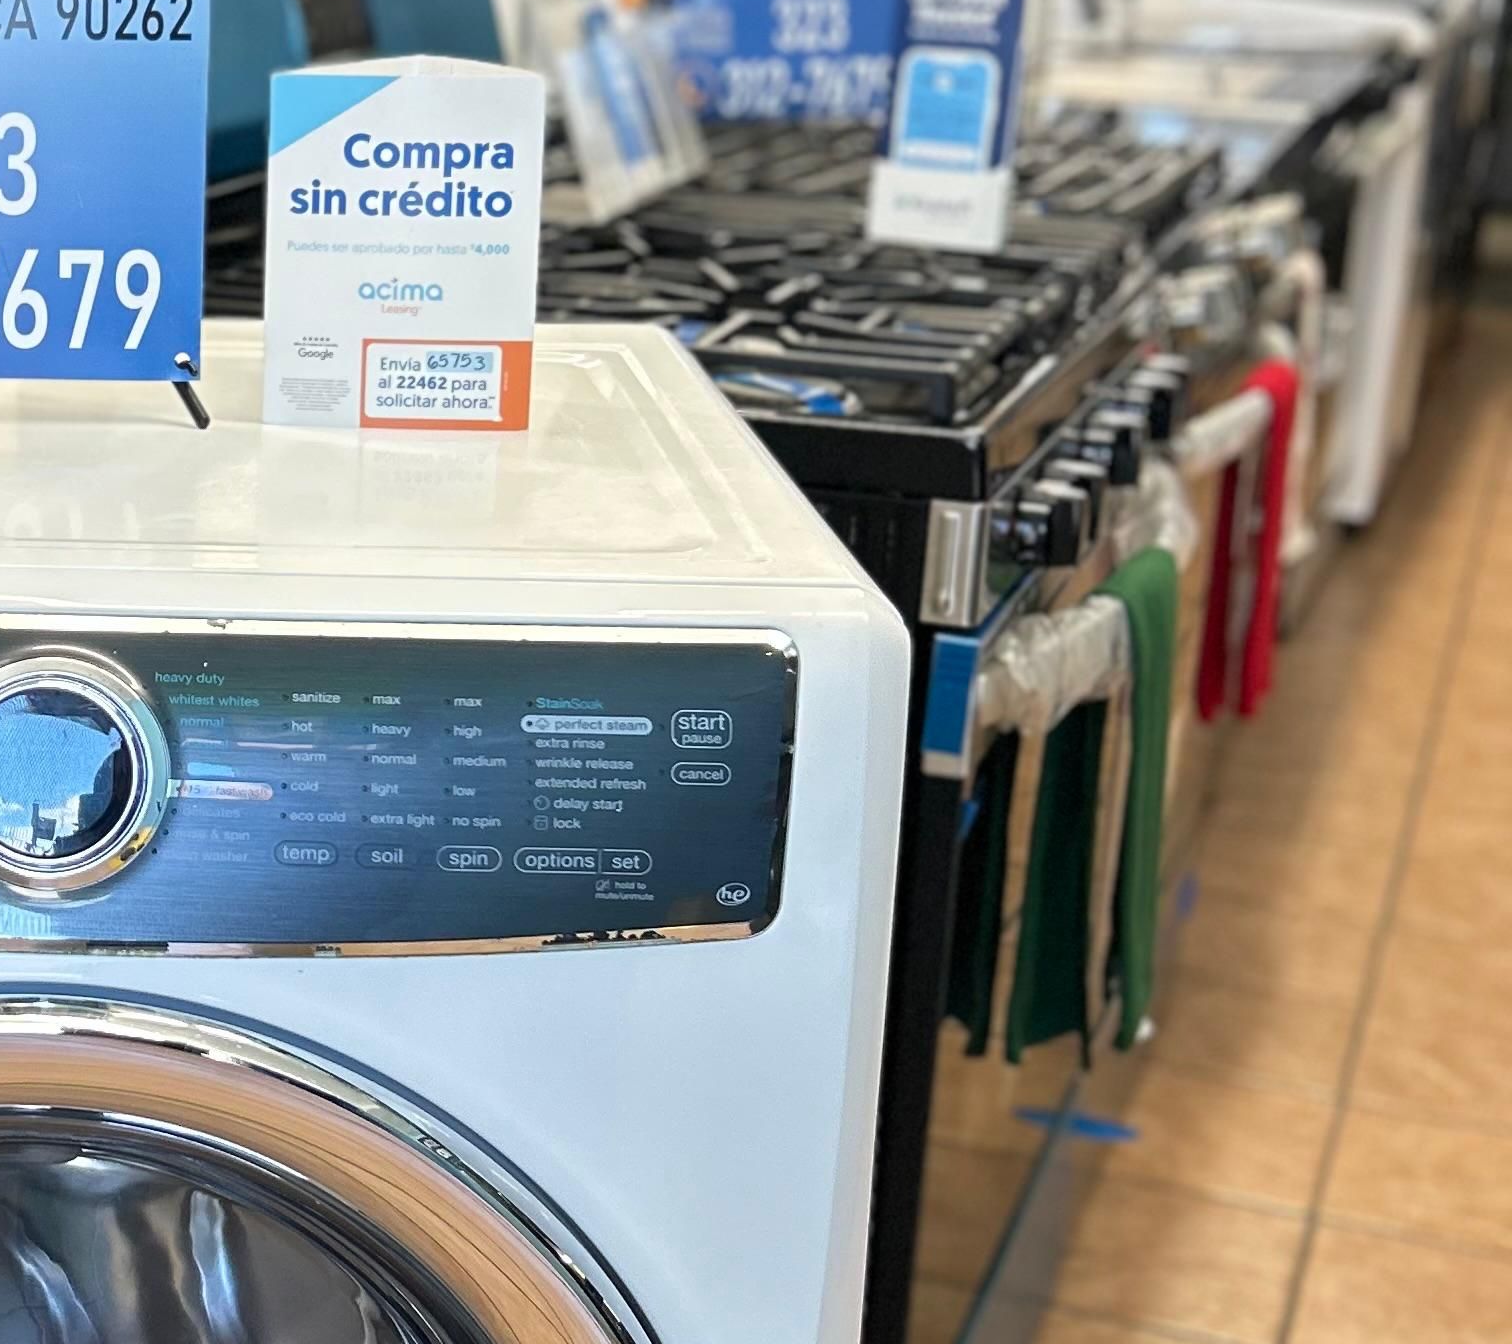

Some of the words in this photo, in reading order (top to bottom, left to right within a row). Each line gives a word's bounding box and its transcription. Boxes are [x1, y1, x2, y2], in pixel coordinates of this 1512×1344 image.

[344, 133, 514, 177] Compra
[290, 179, 346, 215] sin
[359, 181, 512, 217] crédito
[287, 241, 328, 252] Puedes
[332, 243, 348, 253] ser
[352, 242, 410, 255] aprobado
[413, 244, 434, 256] por
[437, 243, 467, 254] hasta
[358, 278, 443, 301] acima
[381, 304, 418, 316] Leasing
[297, 347, 334, 360] Google
[380, 357, 421, 372] Envía
[427, 353, 486, 371] 65753
[378, 375, 391, 388] al
[396, 376, 447, 389] 22462
[451, 379, 487, 392] para
[377, 394, 436, 408] solicitar
[155, 672, 192, 685] heavy
[196, 673, 224, 686] duty
[168, 694, 214, 706] whitest
[219, 695, 260, 707] whites
[291, 692, 340, 703] sanitize
[372, 695, 401, 705] max
[454, 697, 483, 707] max
[535, 697, 604, 710] StainSoak
[179, 716, 224, 728] normal
[291, 721, 313, 733] hot
[554, 718, 602, 733] perfect
[606, 721, 648, 731] steam
[678, 714, 725, 731] start
[371, 724, 411, 737] heavy
[453, 725, 482, 738] high
[535, 739, 569, 749] extra
[572, 738, 605, 750] rinse
[681, 733, 722, 745] pause
[290, 752, 327, 762] warm
[371, 754, 416, 765] normal
[452, 756, 507, 767] medium
[535, 757, 582, 769] wrinkle
[585, 759, 634, 771] release
[678, 768, 724, 781] cancel
[290, 781, 319, 792] cold
[370, 782, 399, 796] light
[535, 777, 597, 790] extended
[600, 778, 646, 791] refresh
[452, 785, 476, 797] low
[553, 798, 589, 812] delay
[592, 798, 623, 811] start
[290, 812, 313, 823] eco
[317, 811, 346, 823] cold
[370, 814, 403, 825] extra
[406, 814, 435, 828] light
[452, 817, 469, 827] no
[472, 816, 501, 830] spin
[552, 817, 581, 829] lock
[223, 831, 250, 843] spin
[282, 844, 330, 864] temp
[371, 848, 403, 864] soil
[448, 851, 489, 869] spin
[525, 852, 595, 869] options
[611, 855, 640, 869] set
[720, 883, 748, 902] he
